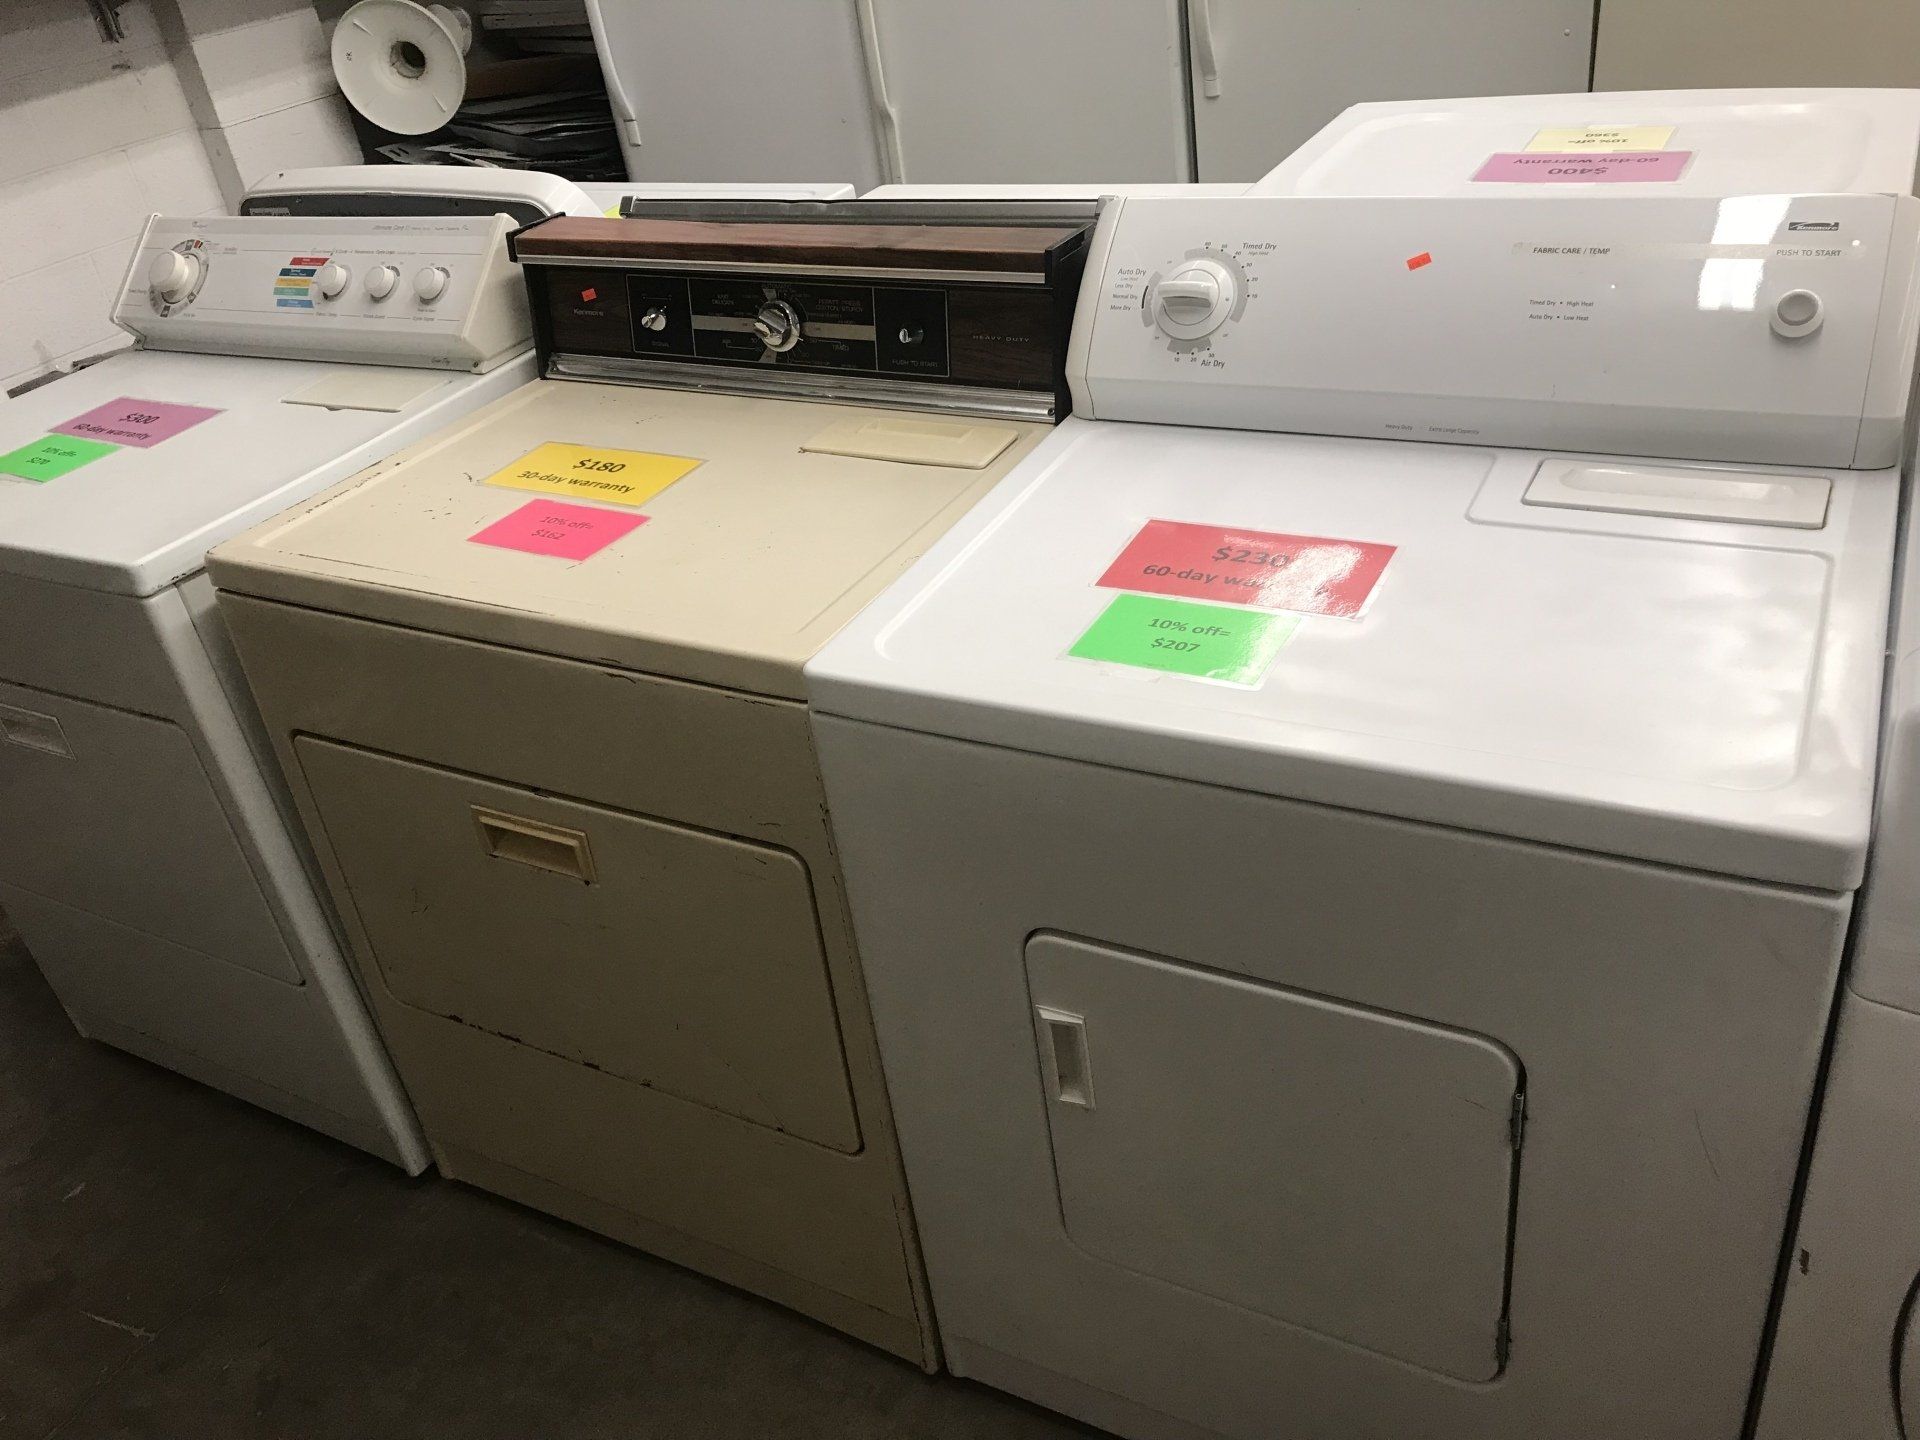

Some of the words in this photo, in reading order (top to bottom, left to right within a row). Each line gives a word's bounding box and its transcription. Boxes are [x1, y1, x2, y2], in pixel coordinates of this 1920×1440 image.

[1548, 166, 1609, 175] $400
[1242, 242, 1264, 250] Timed
[1264, 242, 1277, 251] Dry
[1589, 247, 1611, 255] TEMP
[1776, 249, 1799, 257] PUSH
[1801, 249, 1813, 257] TO
[1814, 249, 1842, 257] START
[1135, 268, 1147, 277] Dry
[1200, 359, 1212, 367] Air
[1213, 360, 1225, 368] Dry
[105, 429, 152, 440] warranty
[572, 458, 627, 474] $180
[517, 470, 567, 484] 30-day
[567, 477, 636, 494] warranty
[540, 515, 567, 526] 10%
[568, 520, 594, 530] off=
[531, 528, 566, 541] $162
[1211, 545, 1290, 568] $230
[1142, 563, 1219, 585] 60-day
[1147, 617, 1189, 633] 10%
[1192, 624, 1231, 637] off=
[1150, 637, 1201, 653] $207
